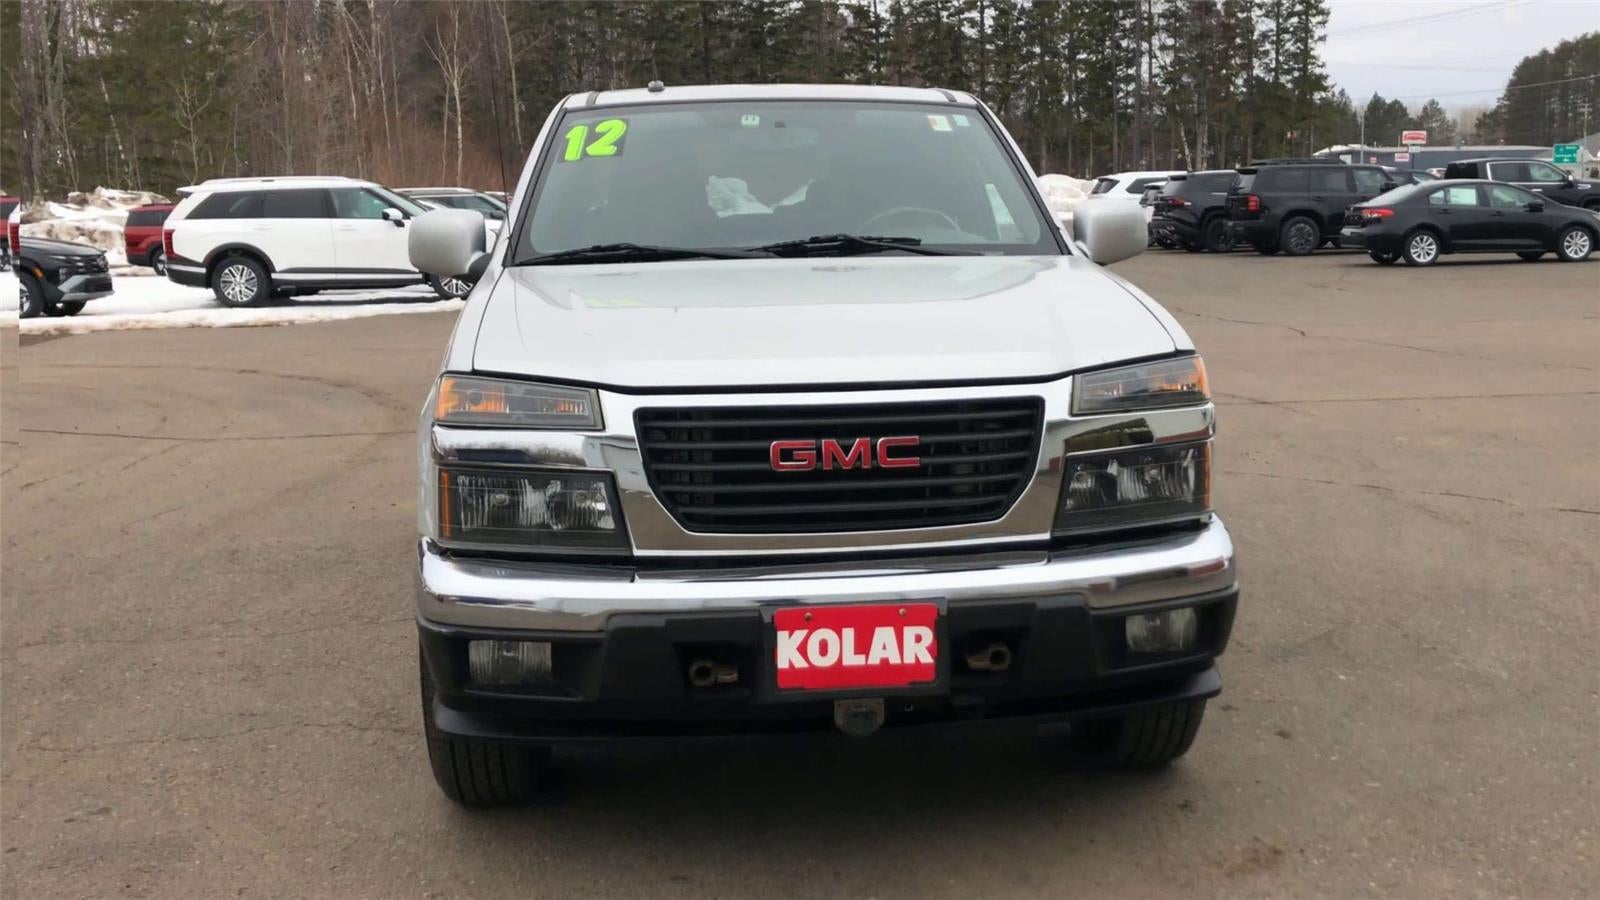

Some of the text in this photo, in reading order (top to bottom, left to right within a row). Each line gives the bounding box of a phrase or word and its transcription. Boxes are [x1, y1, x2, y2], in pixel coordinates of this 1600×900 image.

[564, 119, 627, 161] 12
[770, 435, 921, 472] GMC
[776, 625, 935, 669] KOLAR
